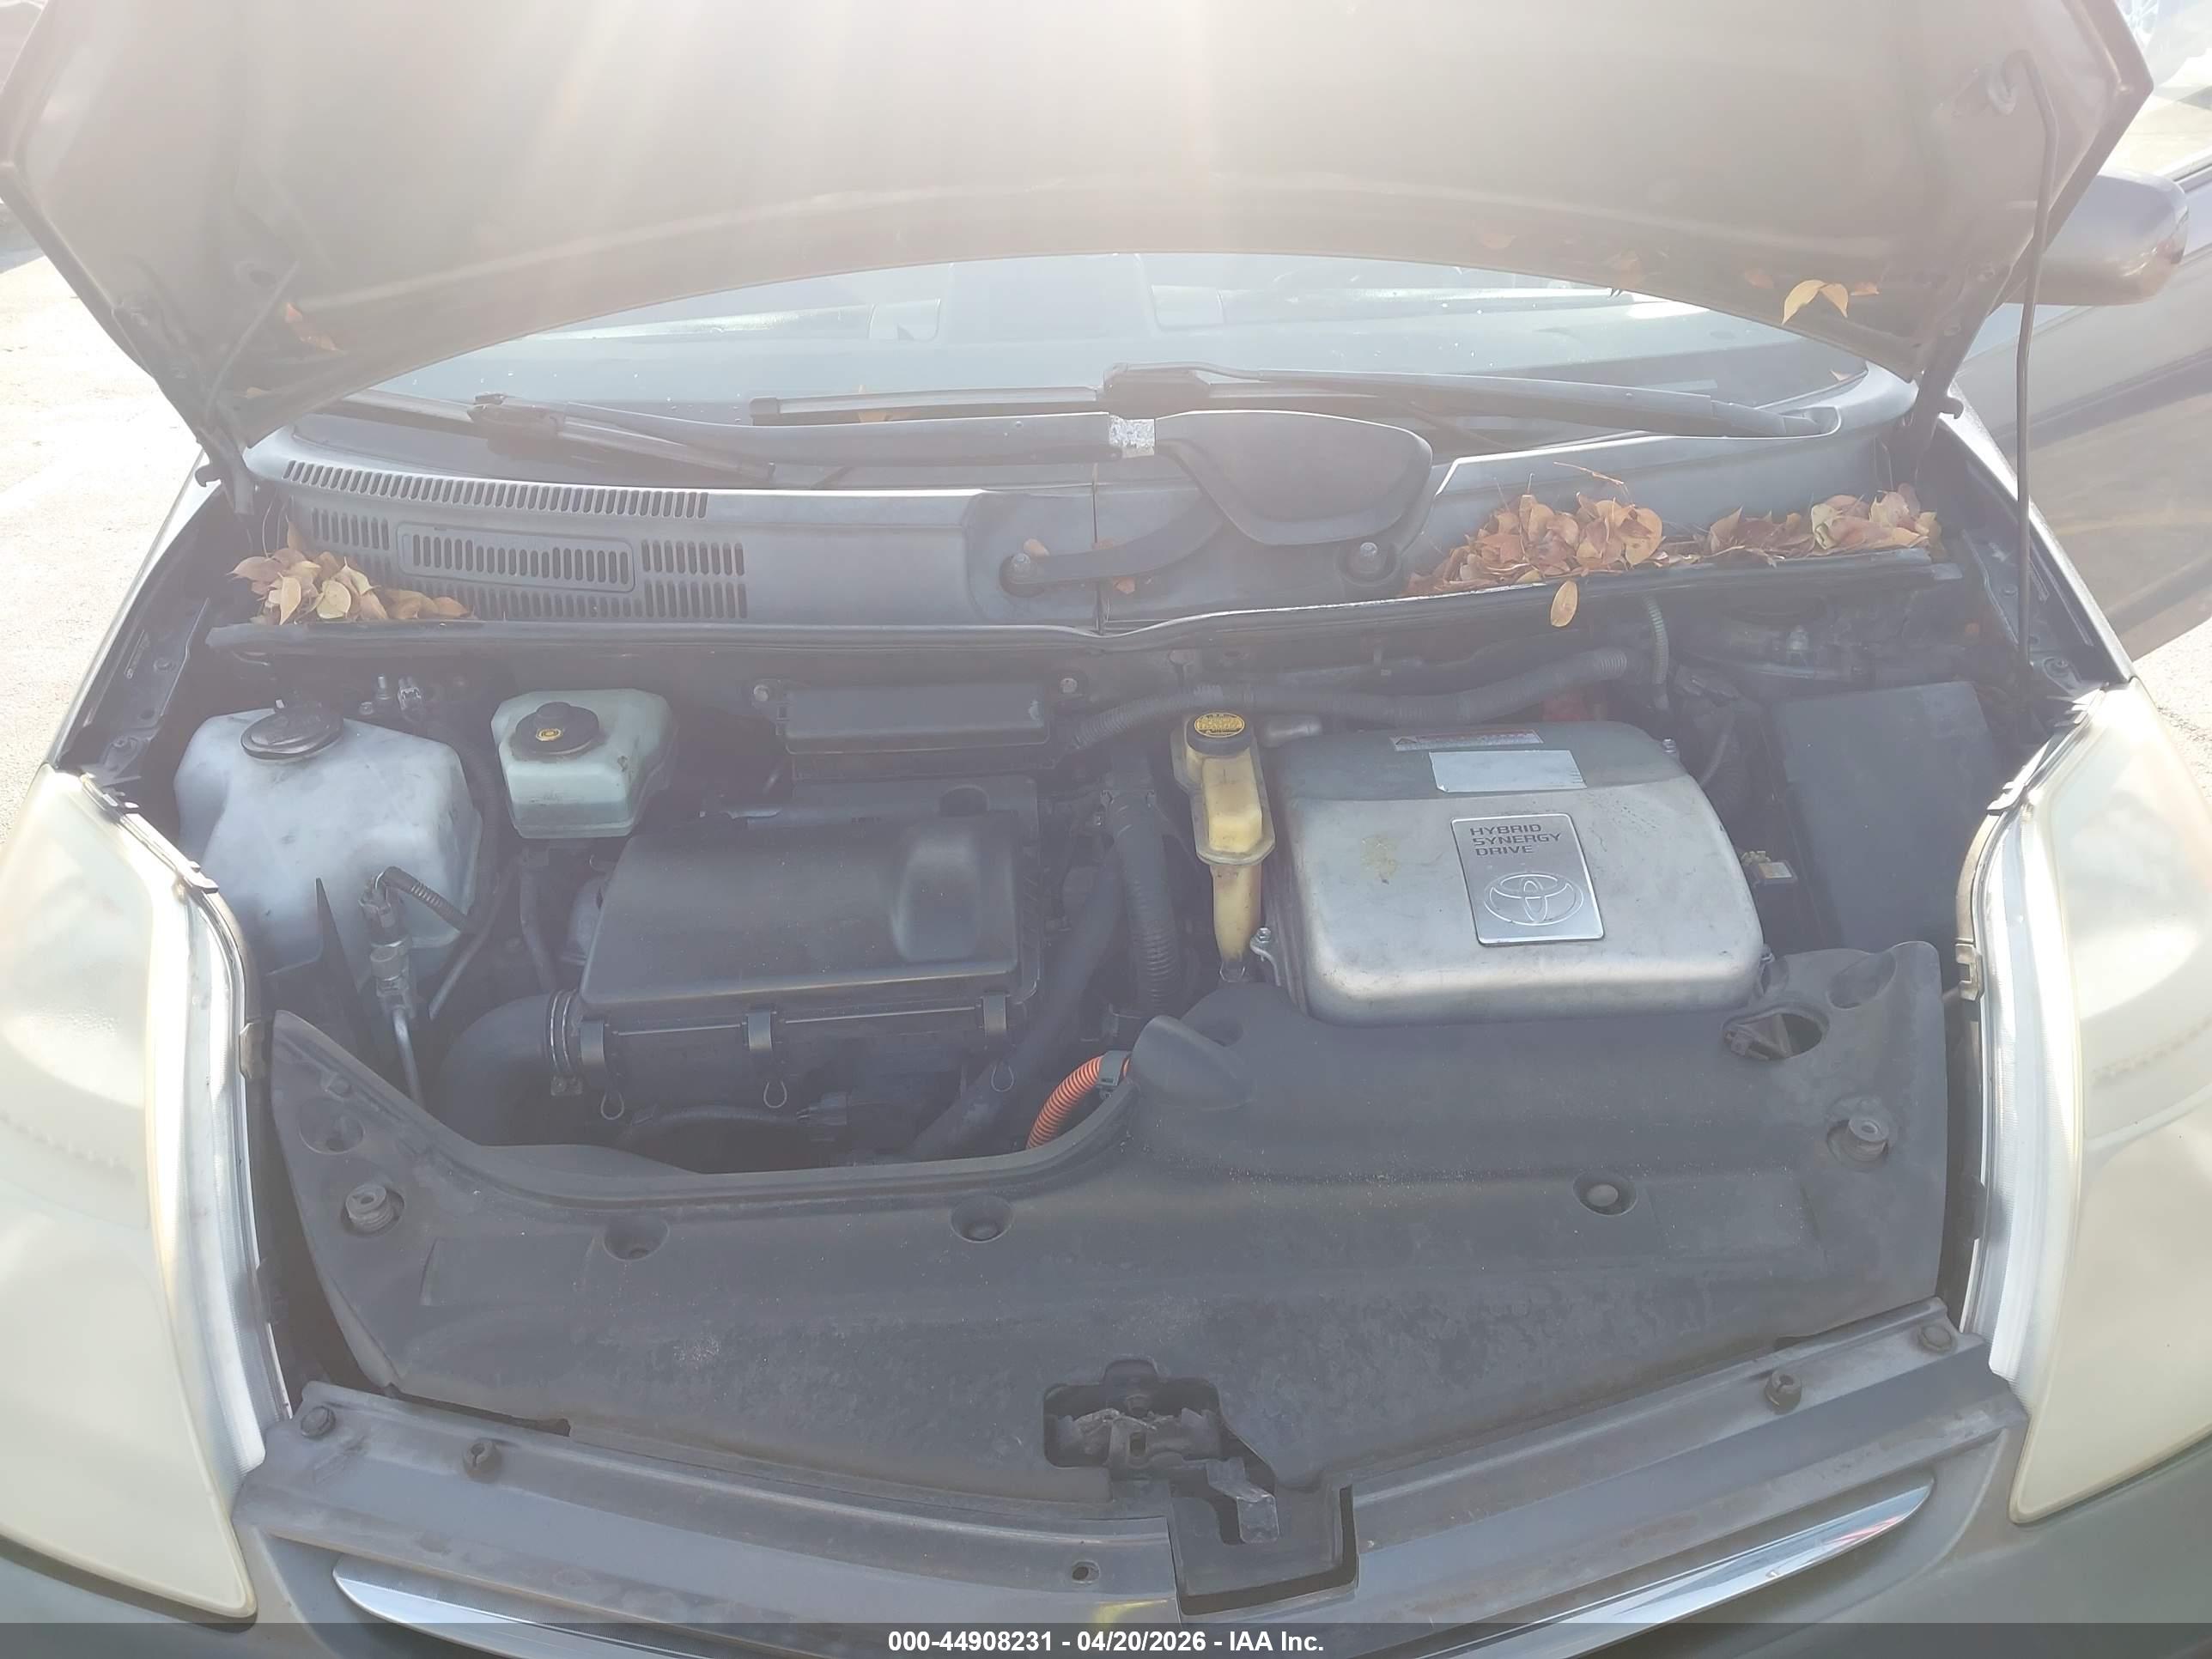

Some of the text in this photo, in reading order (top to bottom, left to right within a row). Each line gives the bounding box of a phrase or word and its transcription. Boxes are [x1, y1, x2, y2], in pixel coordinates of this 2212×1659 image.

[1470, 824, 1541, 836] HYBRID
[1473, 833, 1560, 847] SYNERGY
[1476, 845, 1533, 856] DRIVE
